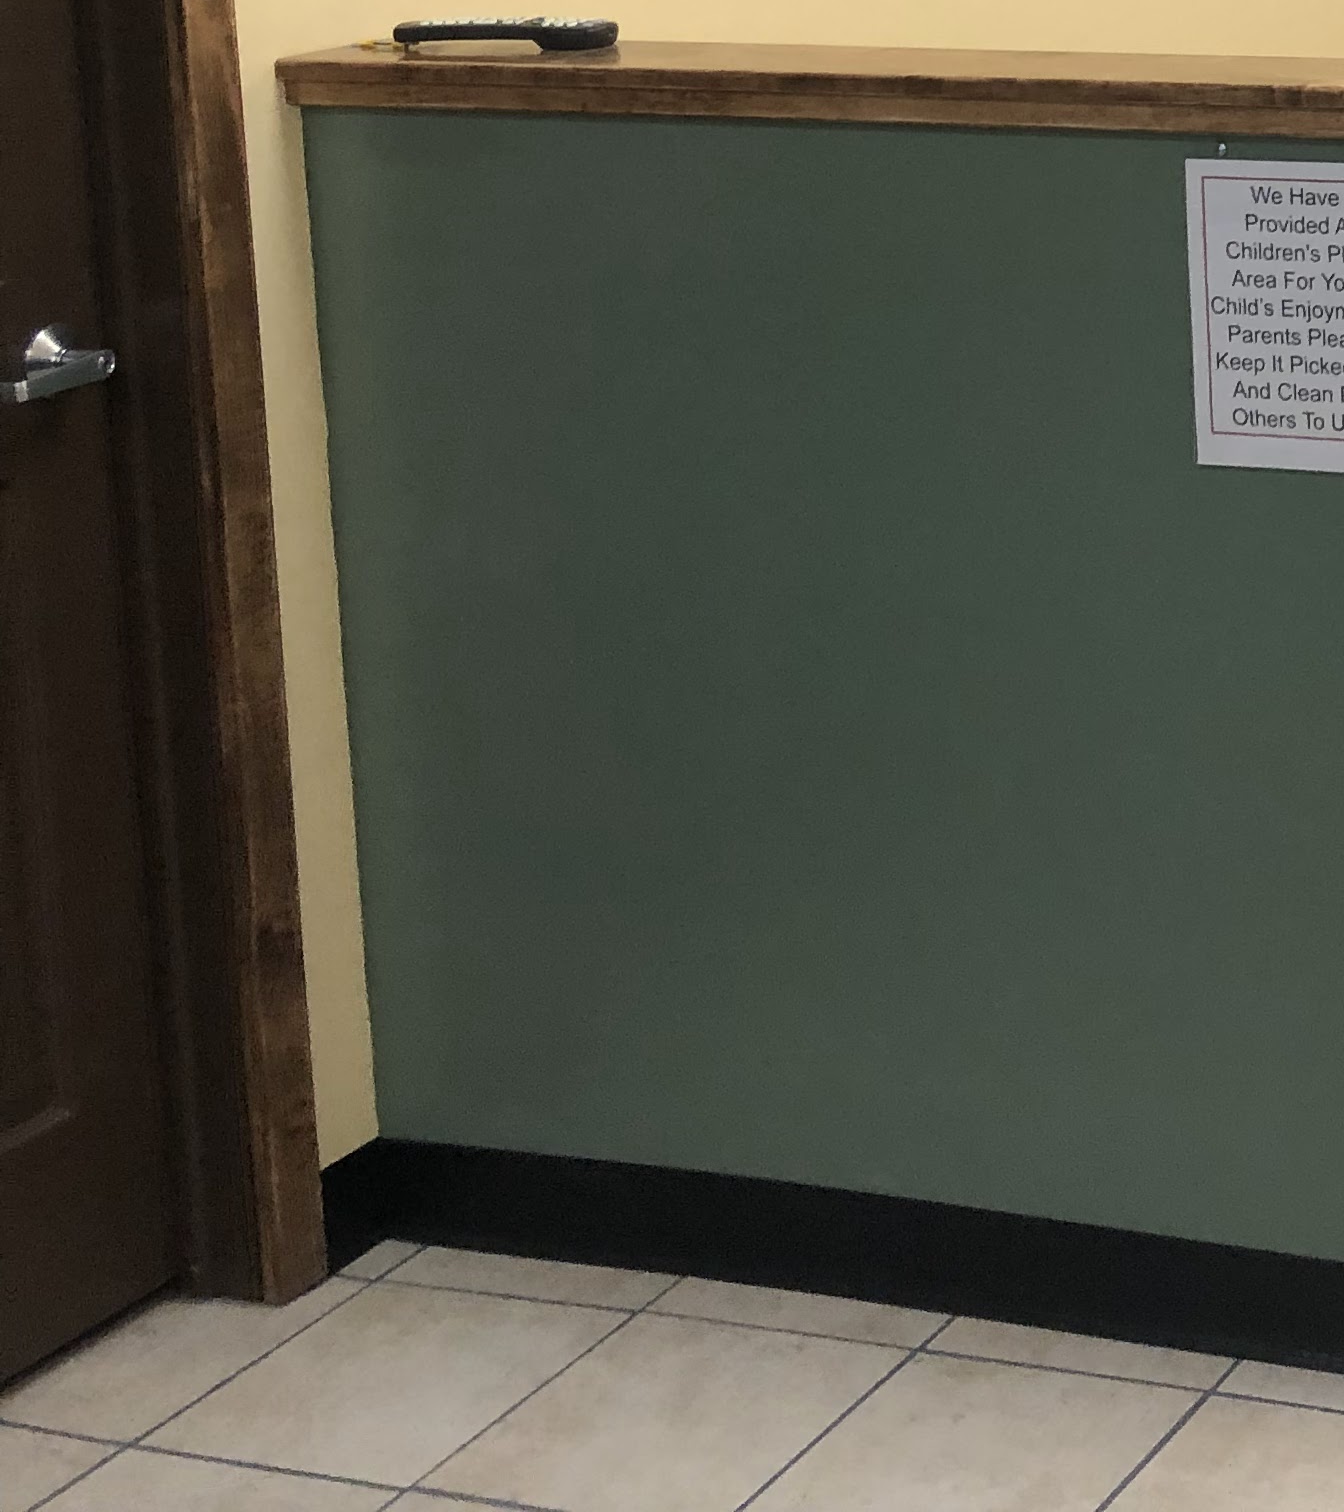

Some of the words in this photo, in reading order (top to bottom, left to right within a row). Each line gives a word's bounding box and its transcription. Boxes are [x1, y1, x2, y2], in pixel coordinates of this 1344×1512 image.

[1250, 186, 1283, 205] We
[1290, 188, 1340, 207] Have
[1245, 214, 1330, 234] Provided
[1225, 241, 1321, 263] Children's
[1231, 270, 1277, 288] Area
[1284, 271, 1315, 291] For
[1211, 296, 1274, 318] Child's
[1228, 325, 1302, 346] Parents
[1216, 352, 1265, 376] Keep
[1272, 355, 1284, 373] It
[1233, 381, 1271, 400] And
[1277, 383, 1333, 403] Clean
[1232, 408, 1297, 429] Others
[1302, 411, 1325, 430] To
